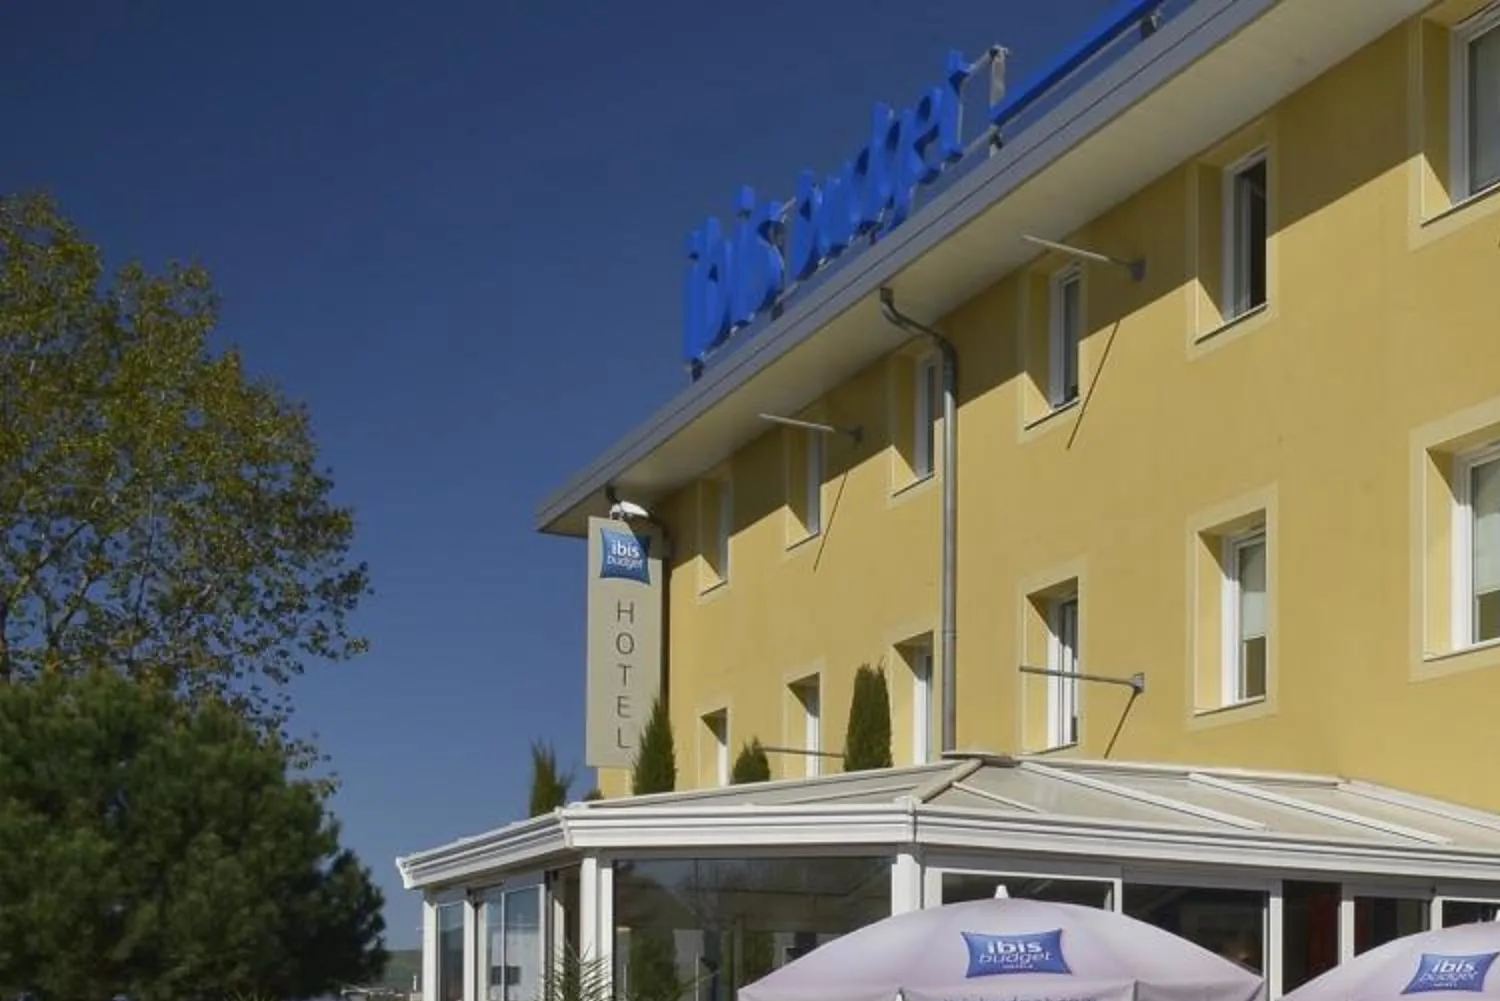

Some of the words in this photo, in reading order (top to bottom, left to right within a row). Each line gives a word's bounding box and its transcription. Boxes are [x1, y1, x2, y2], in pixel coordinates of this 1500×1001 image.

[611, 539, 640, 558] ibis
[607, 555, 643, 570] budget
[615, 600, 635, 750] HOTEL
[987, 940, 1043, 954] ibis
[979, 951, 1053, 965] budget
[1432, 959, 1475, 973] ibis
